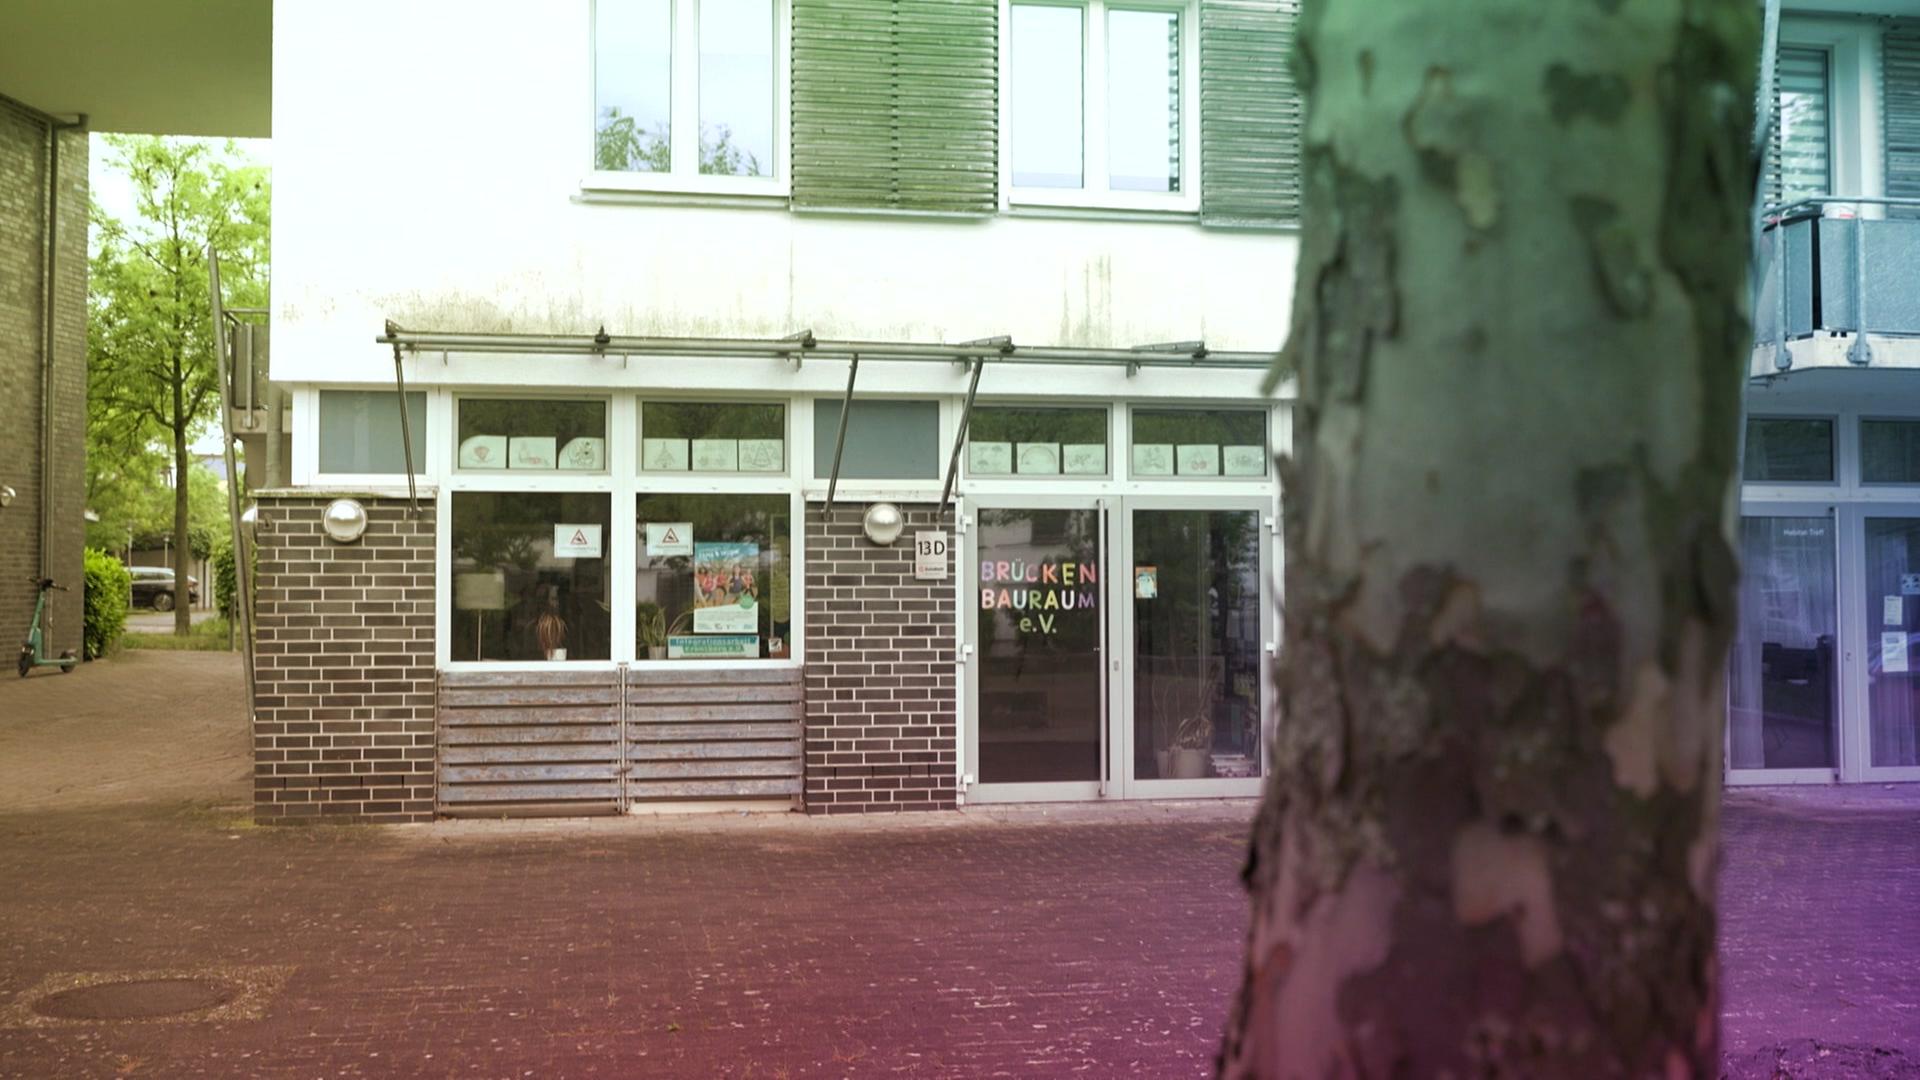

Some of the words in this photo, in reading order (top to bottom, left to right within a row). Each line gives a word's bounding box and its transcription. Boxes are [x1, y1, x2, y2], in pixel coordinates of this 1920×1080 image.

[918, 541, 931, 555] 13
[934, 541, 945, 555] D
[981, 558, 1096, 586] BRÜCKEN
[981, 588, 1095, 610] BAURAUM
[1019, 614, 1057, 634] e.V.
